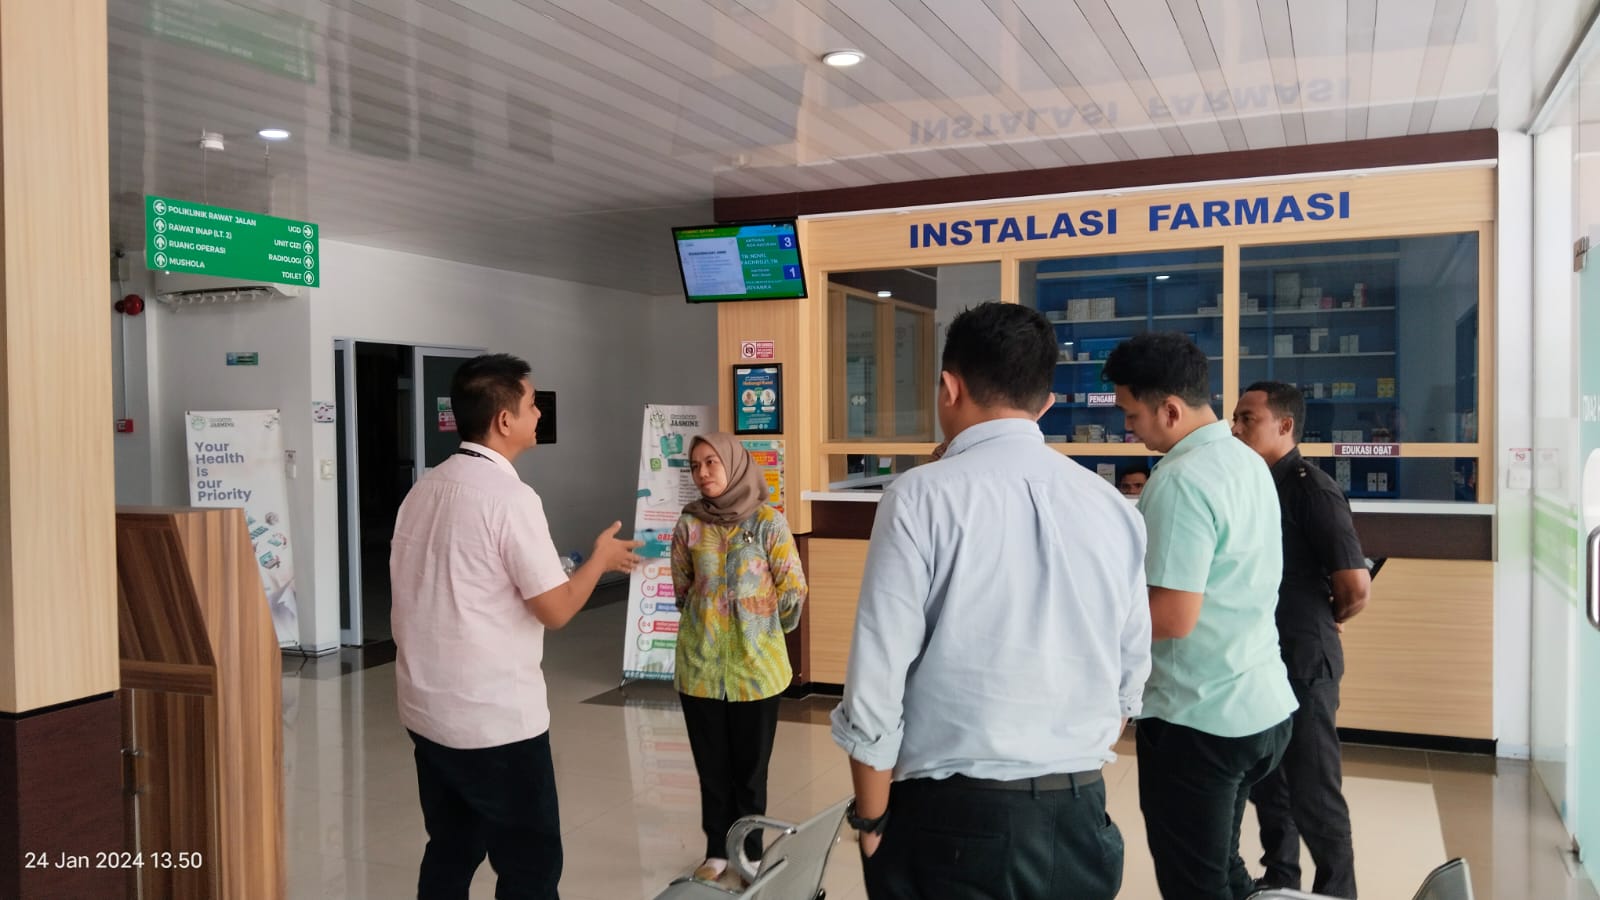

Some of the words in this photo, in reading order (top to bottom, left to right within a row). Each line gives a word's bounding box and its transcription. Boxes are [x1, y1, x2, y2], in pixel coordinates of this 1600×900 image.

[168, 205, 207, 219] POLIKLINIK
[208, 211, 233, 223] RAWAT
[235, 216, 257, 227] JALAN
[909, 208, 1117, 249] INSTALASI
[1148, 191, 1350, 232] FARMASI
[168, 223, 195, 234] RAWAT
[195, 226, 213, 236] INAP
[287, 225, 302, 234] UGD
[168, 240, 195, 250] RUANG
[195, 243, 226, 254] OPERASI
[273, 239, 289, 247] UNIT
[783, 236, 792, 248] 3
[169, 257, 205, 269] MUSHOLA
[268, 253, 302, 264] RADIOLOGI
[281, 271, 302, 280] TOILET
[789, 267, 796, 278] 1
[670, 420, 699, 428] JASMINE
[194, 441, 230, 453] Your
[1341, 445, 1372, 455] EDUKASI
[1372, 445, 1393, 455] OBAT
[195, 452, 245, 465] Health
[197, 480, 223, 490] our
[198, 488, 252, 503] Priority
